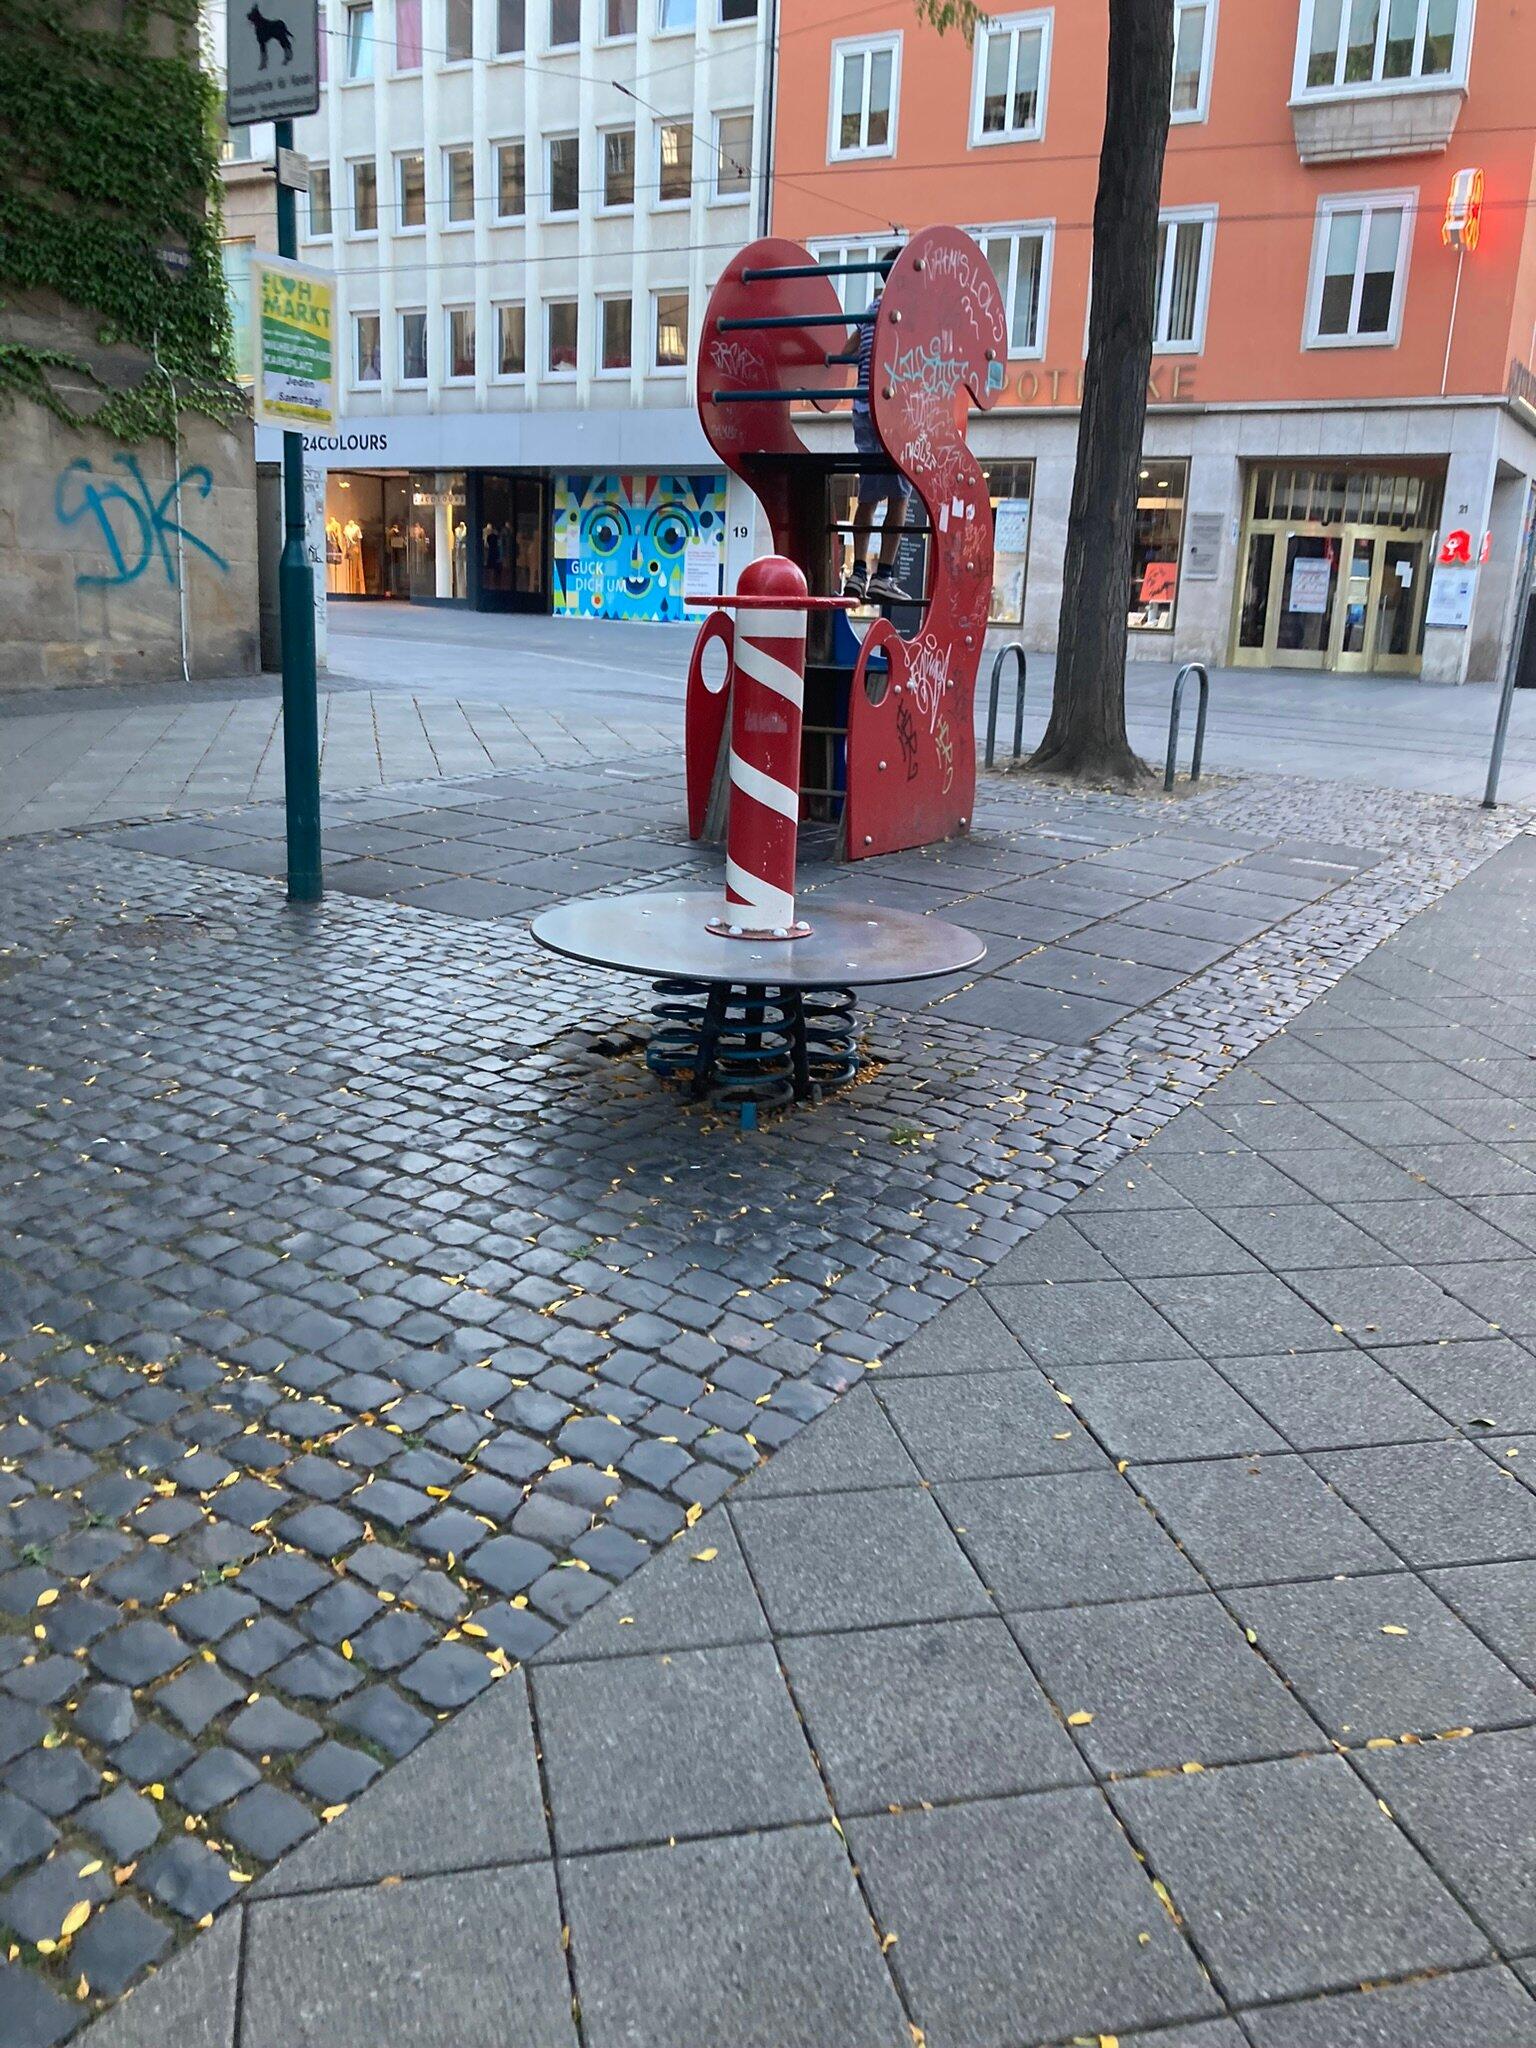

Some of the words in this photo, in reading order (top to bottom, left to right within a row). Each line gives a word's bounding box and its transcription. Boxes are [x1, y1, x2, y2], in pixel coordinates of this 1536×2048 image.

[262, 297, 331, 328] MARKT
[286, 376, 315, 389] Jeden
[302, 434, 388, 451] 24COLOURS
[1458, 504, 1469, 514] 21
[732, 526, 749, 538] 19
[571, 561, 604, 575] GUCK
[575, 577, 604, 592] DICH
[606, 579, 627, 593] UM
